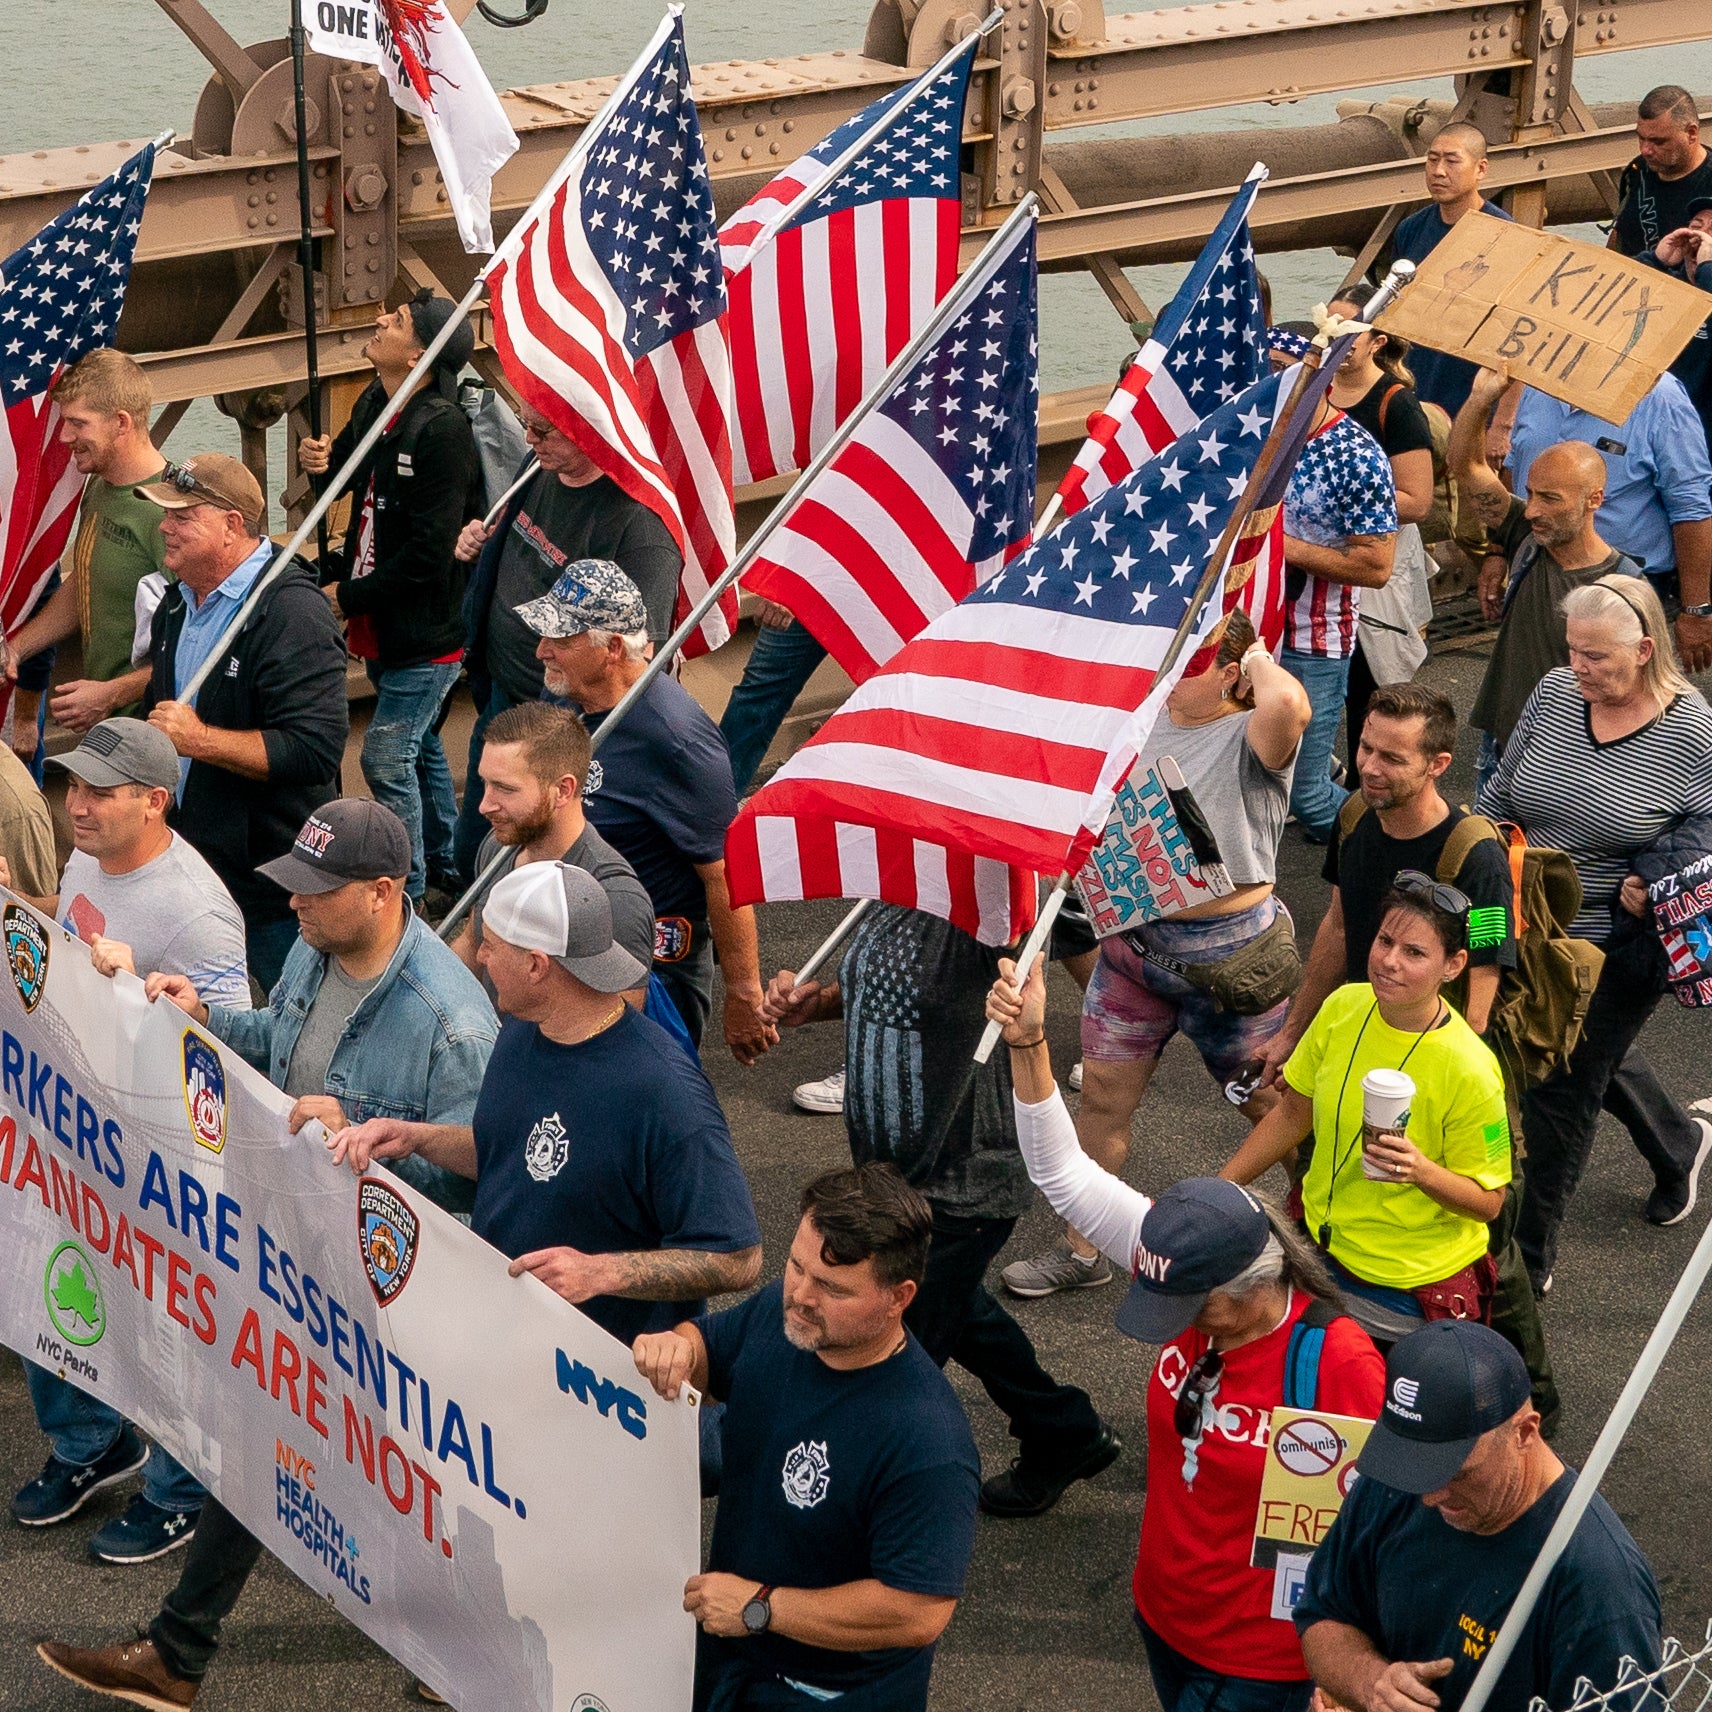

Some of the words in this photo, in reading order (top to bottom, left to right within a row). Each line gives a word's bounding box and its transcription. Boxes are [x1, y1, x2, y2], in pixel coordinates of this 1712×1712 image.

[317, 1, 369, 40] ONE
[1529, 251, 1638, 327] Kill
[1497, 316, 1590, 382] Bill
[1116, 779, 1146, 828] IS
[1138, 768, 1198, 876] THIS
[296, 820, 335, 853] DNY
[1094, 845, 1125, 892] IS
[1111, 894, 1136, 925] A
[1106, 821, 1162, 922] MASK
[1130, 823, 1188, 910] NOT
[4, 919, 48, 956] DEPARTMENT
[15, 908, 40, 933] POLICE
[1469, 936, 1502, 949] DSNY
[36, 962, 47, 990] YORK
[361, 1198, 415, 1243] DEPARTMENT
[362, 1185, 416, 1231] CORRECTION
[360, 1227, 370, 1258] CITY
[367, 1263, 377, 1281] OF
[383, 1277, 401, 1296] NEW
[399, 1245, 415, 1278] YORK
[36, 1332, 63, 1362] NYC
[63, 1347, 99, 1383] Parks
[139, 1149, 242, 1274] ARE
[256, 1224, 528, 1520] ESSENTIAL.
[555, 1347, 647, 1441] NYC
[230, 1307, 330, 1440] ARE
[344, 1409, 453, 1559] NOT.
[275, 1437, 316, 1491] NYC
[275, 1466, 344, 1550] HEALTH
[275, 1495, 372, 1605] HOSPITALS
[1463, 1637, 1486, 1661] NY
